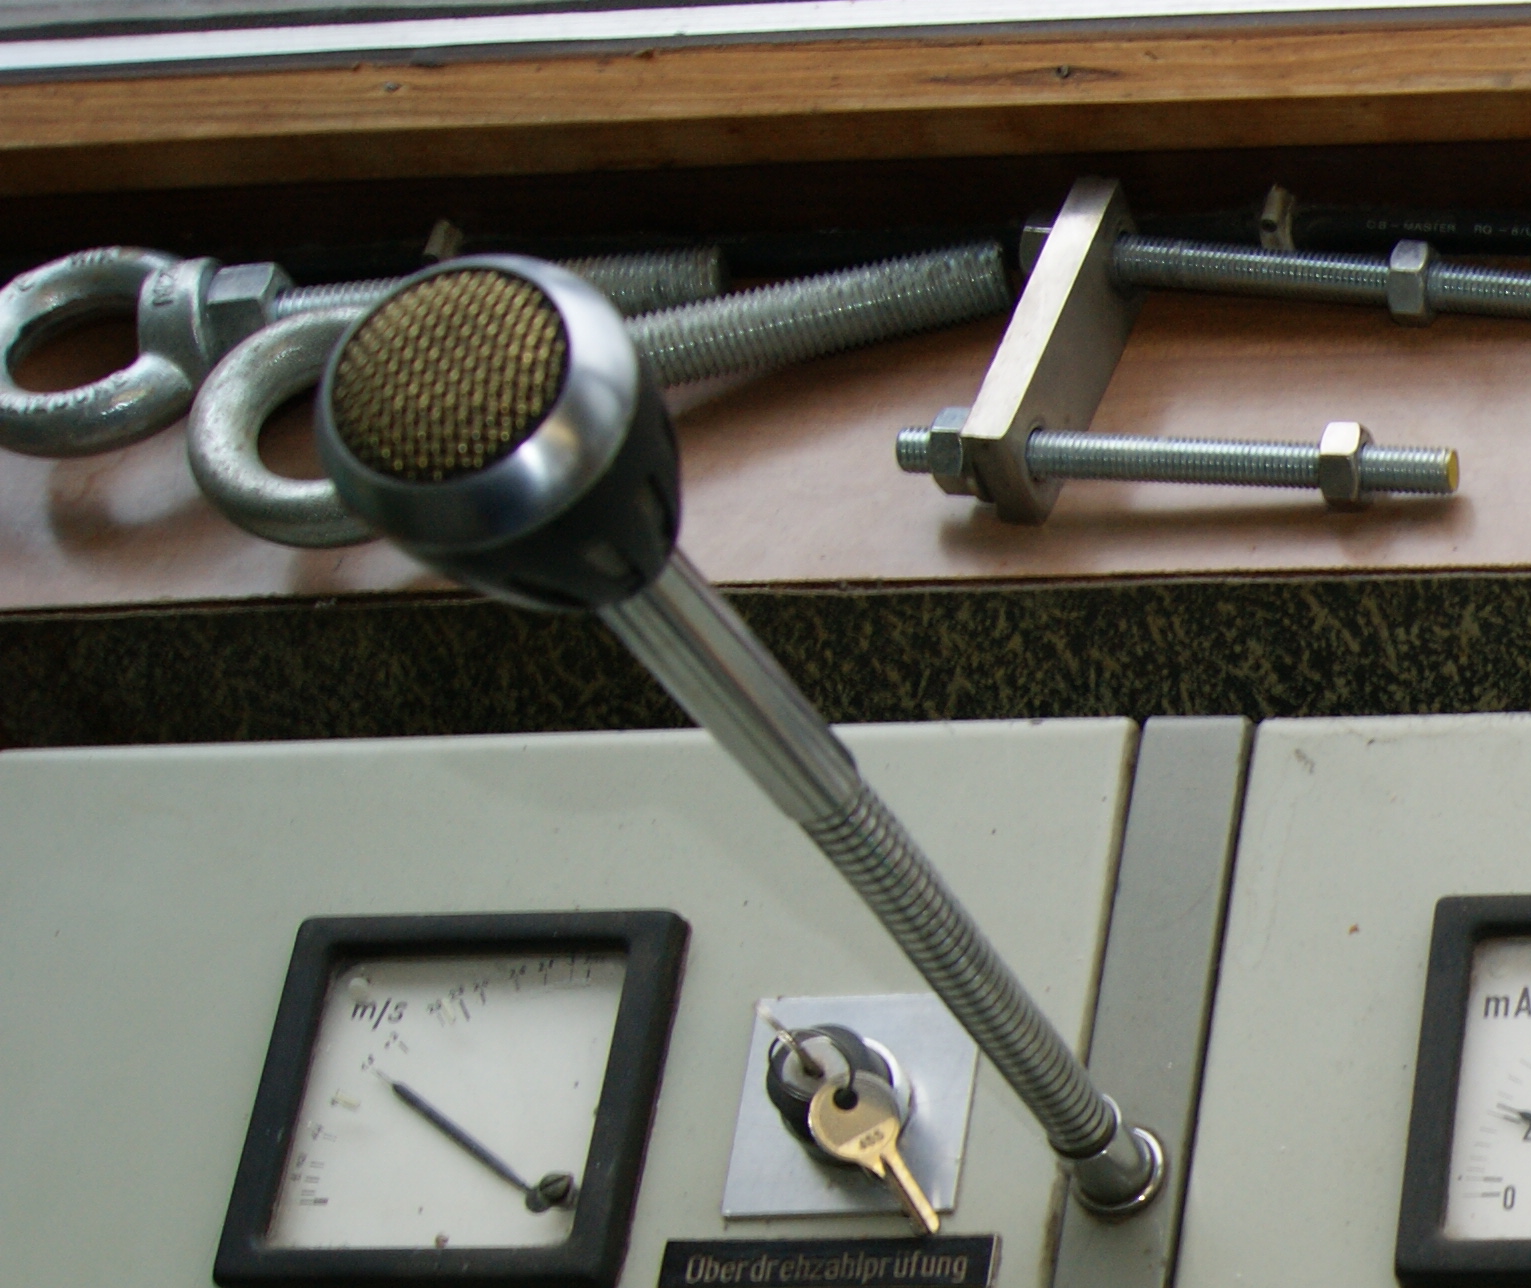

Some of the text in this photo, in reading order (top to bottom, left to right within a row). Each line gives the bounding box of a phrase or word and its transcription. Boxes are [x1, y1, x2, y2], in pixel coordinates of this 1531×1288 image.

[351, 997, 407, 1031] m/s
[1503, 1186, 1516, 1210] 0
[685, 1252, 969, 1286] Überdrehzahlprüfung
